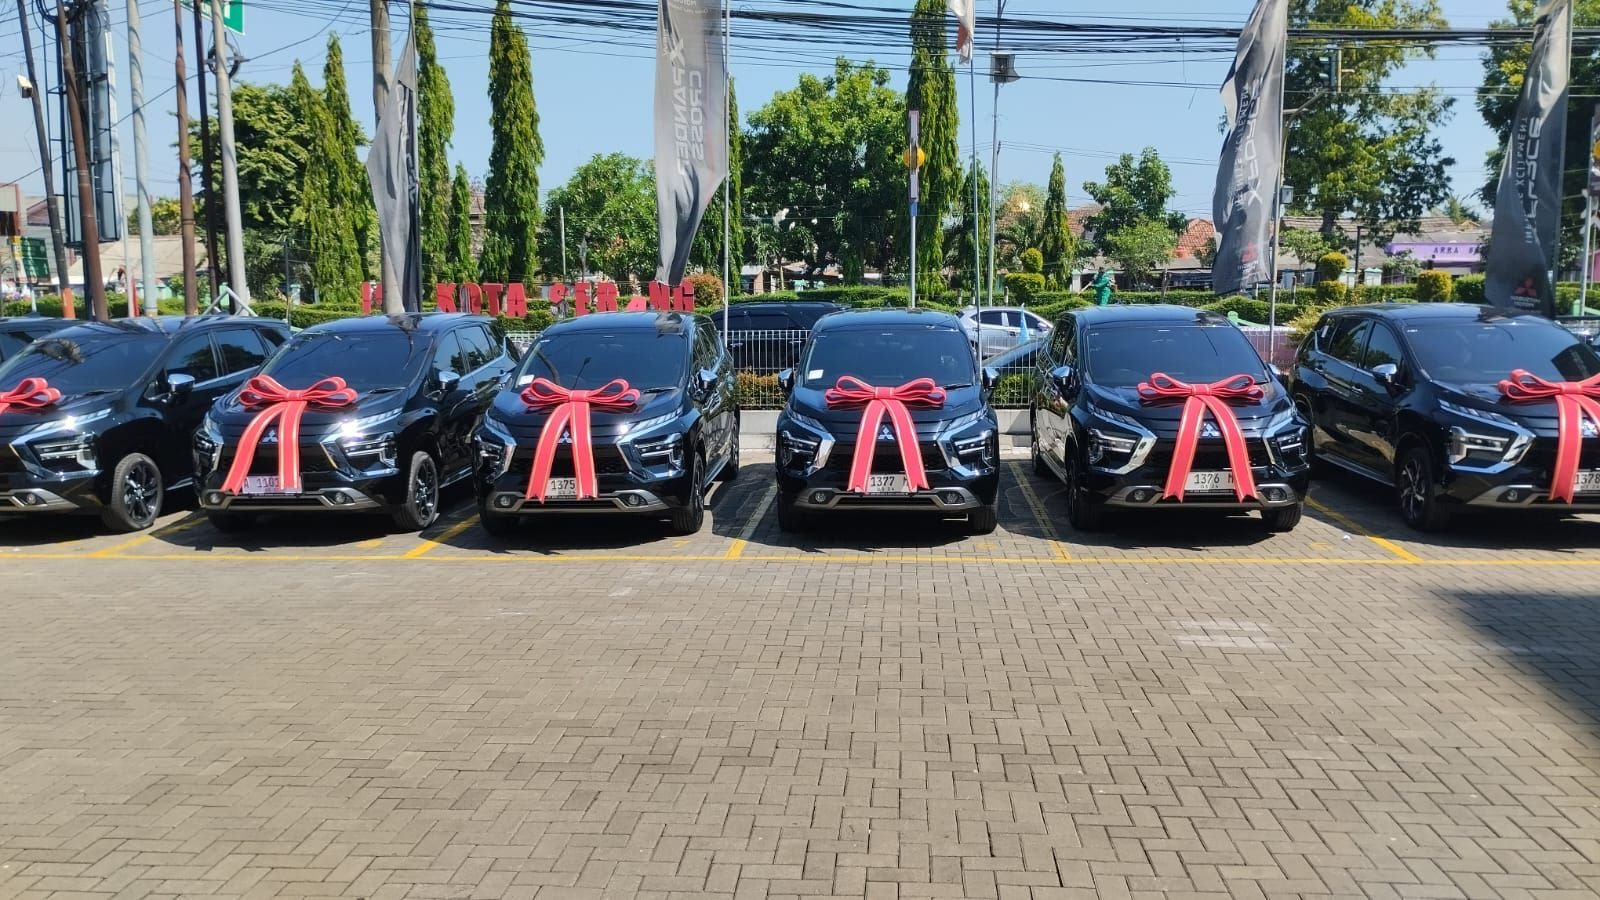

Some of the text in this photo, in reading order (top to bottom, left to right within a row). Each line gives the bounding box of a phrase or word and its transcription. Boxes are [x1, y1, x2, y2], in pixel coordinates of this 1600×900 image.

[436, 281, 528, 318] KOTA
[870, 476, 895, 487] 1377
[1193, 473, 1220, 484] 1376
[1575, 473, 1600, 484] 1378
[551, 479, 576, 490] 1375
